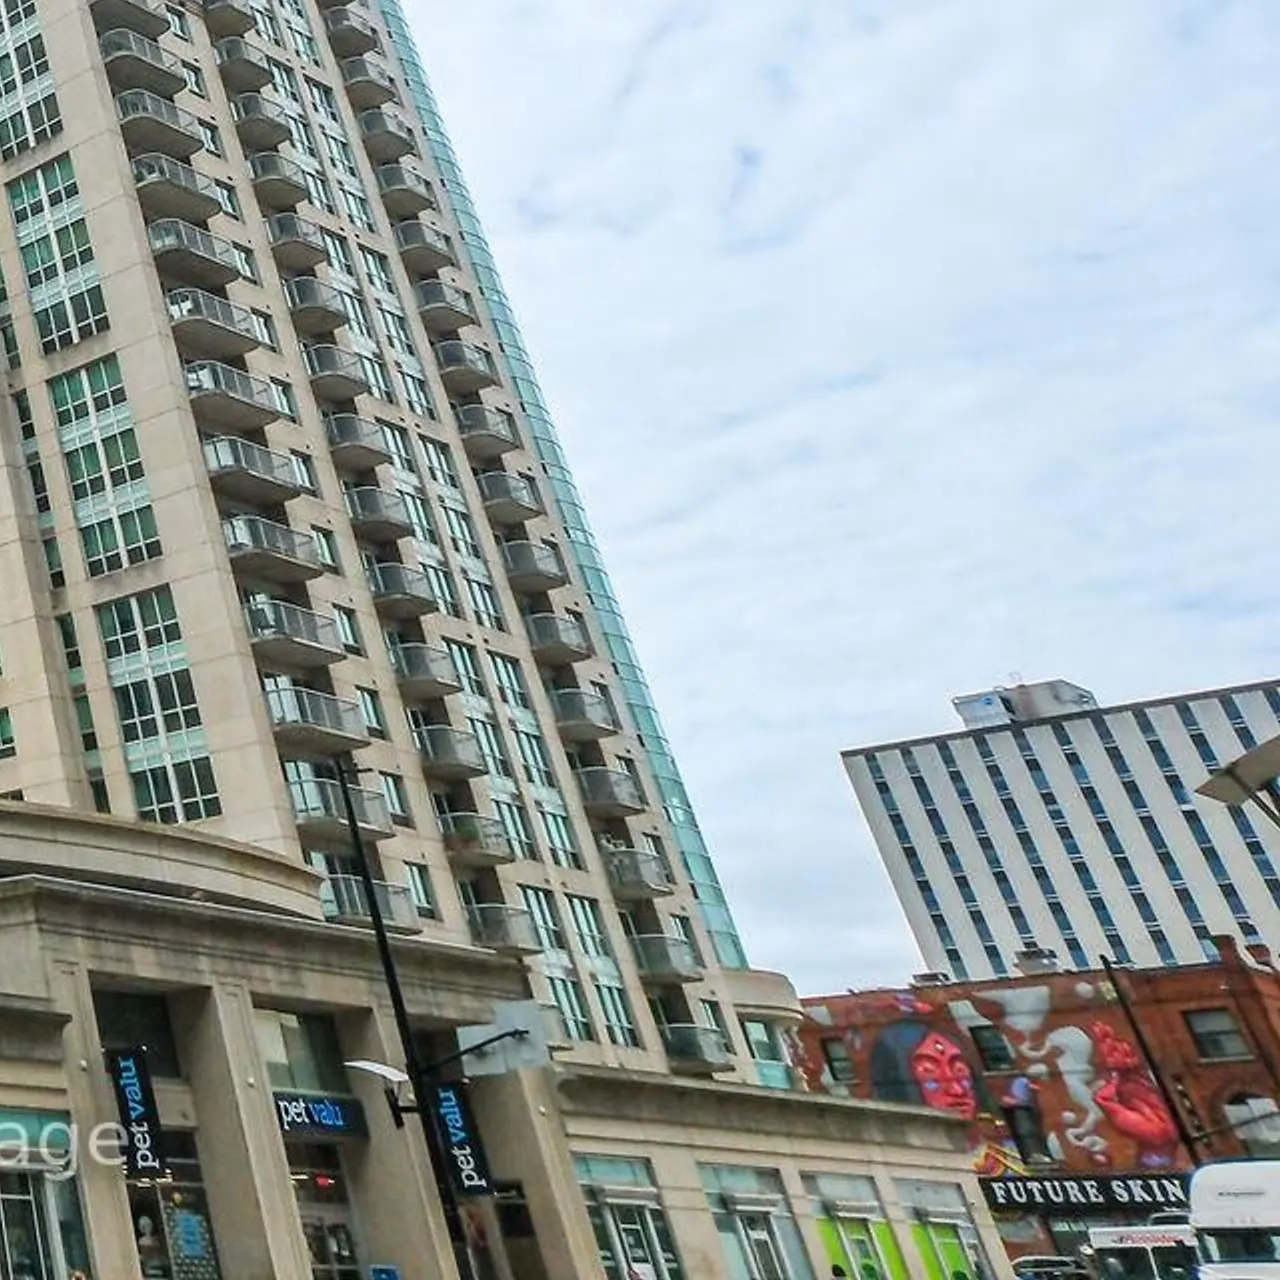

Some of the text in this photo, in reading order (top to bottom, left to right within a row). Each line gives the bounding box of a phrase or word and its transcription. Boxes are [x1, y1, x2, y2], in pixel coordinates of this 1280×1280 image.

[117, 1056, 161, 1170] pet valu
[278, 1098, 345, 1130] pet valu
[438, 1088, 487, 1190] pet valu
[991, 1178, 1188, 1205] FUTURE SKIN
